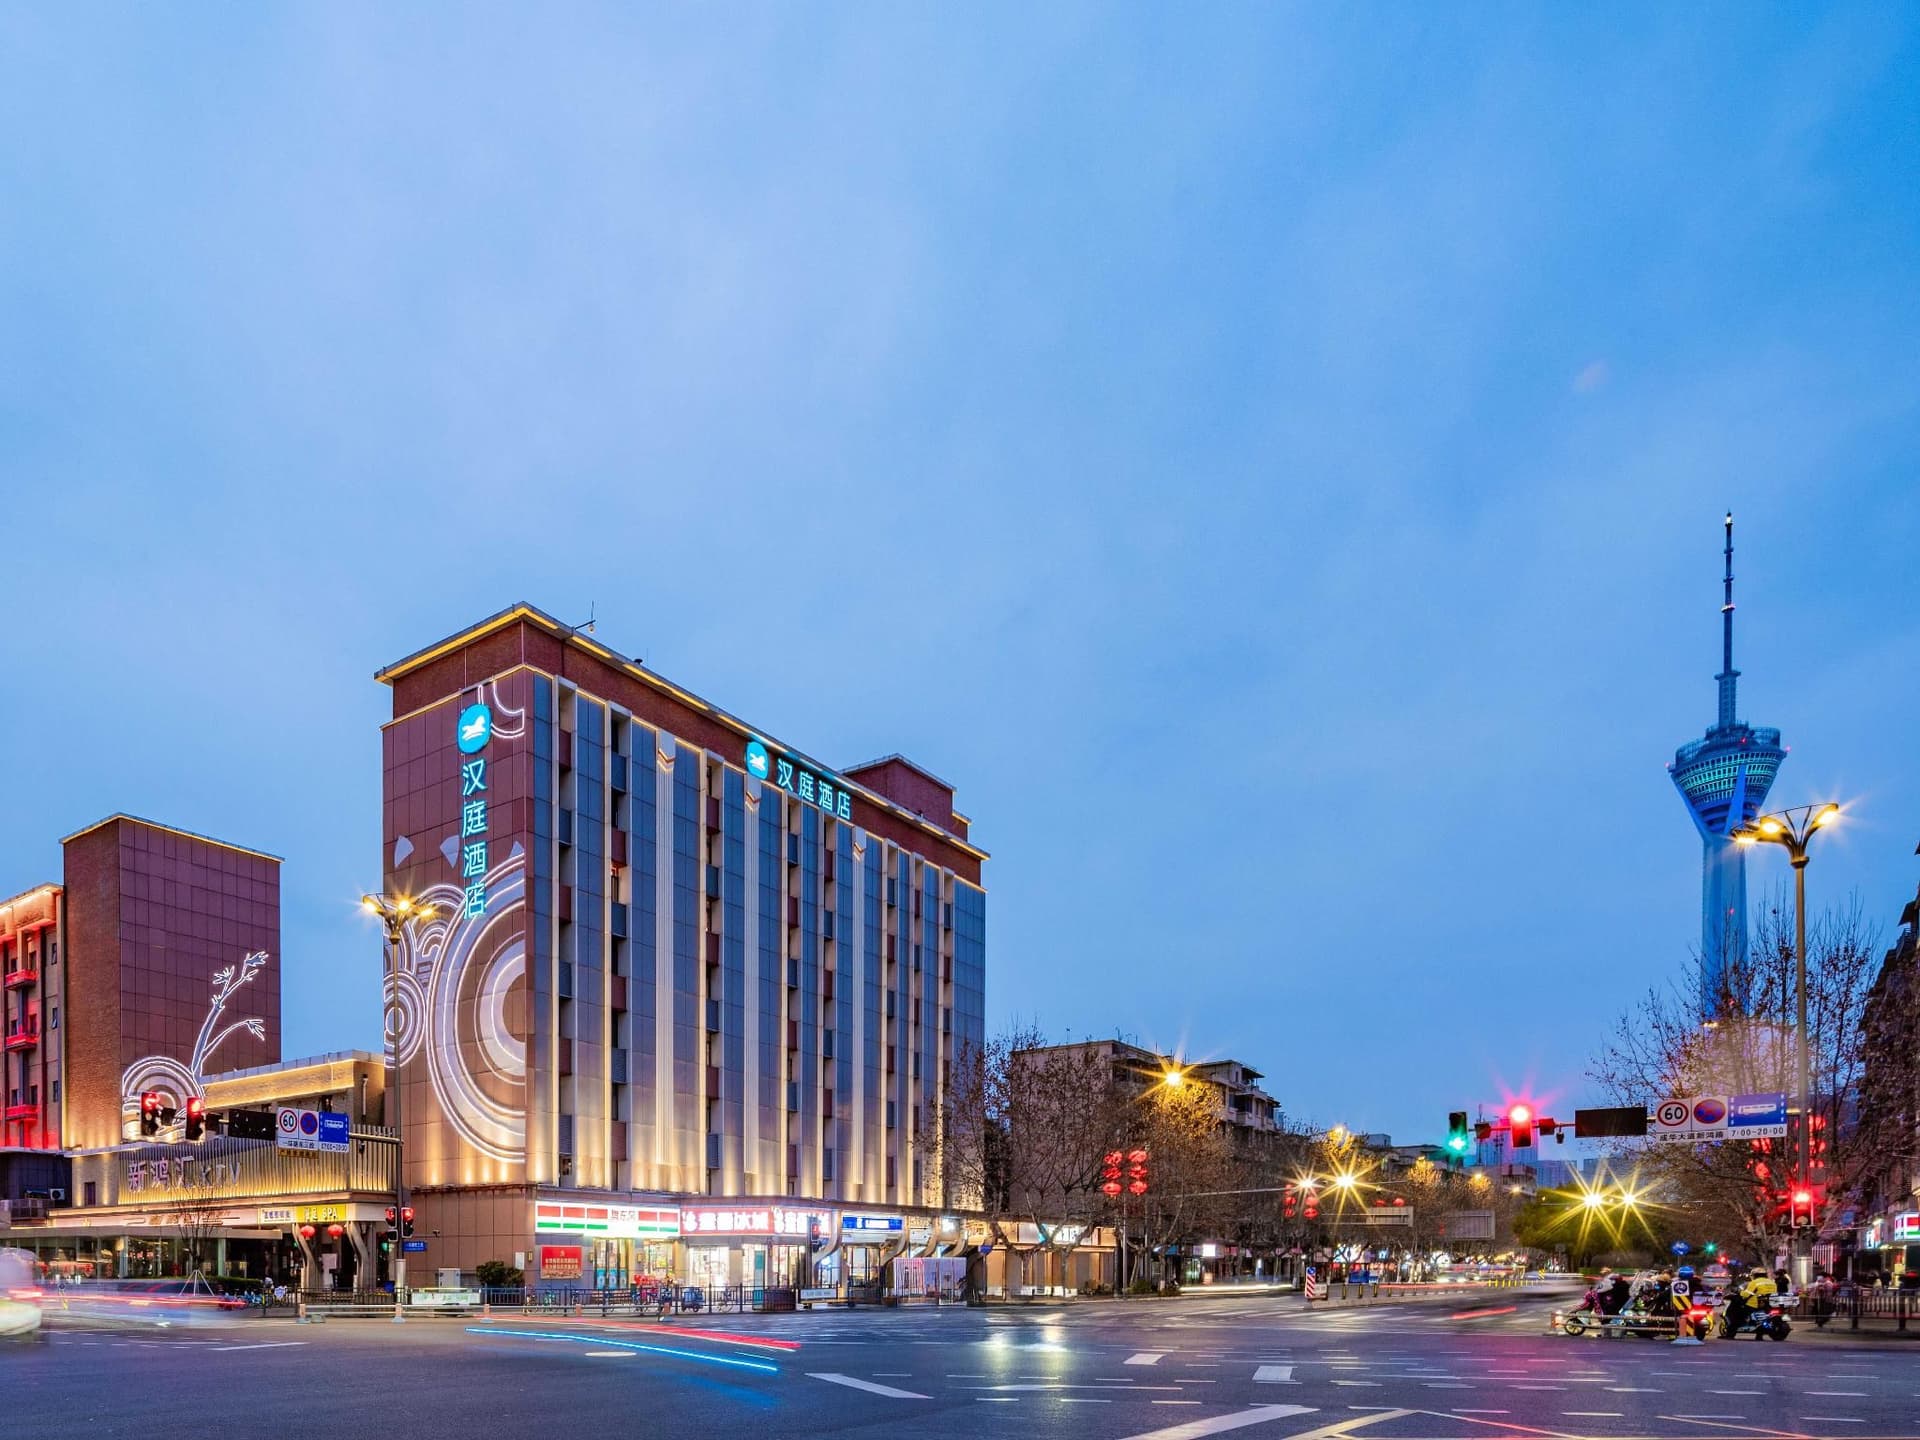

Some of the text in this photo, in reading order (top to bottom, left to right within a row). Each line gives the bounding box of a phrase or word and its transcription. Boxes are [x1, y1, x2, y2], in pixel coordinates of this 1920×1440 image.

[776, 758, 852, 821] 汉庭酒店
[462, 757, 489, 920] 汉庭酒店
[282, 1114, 295, 1128] 60
[1664, 1106, 1684, 1121] 60
[128, 1156, 241, 1193] 新鸿汇 KTV
